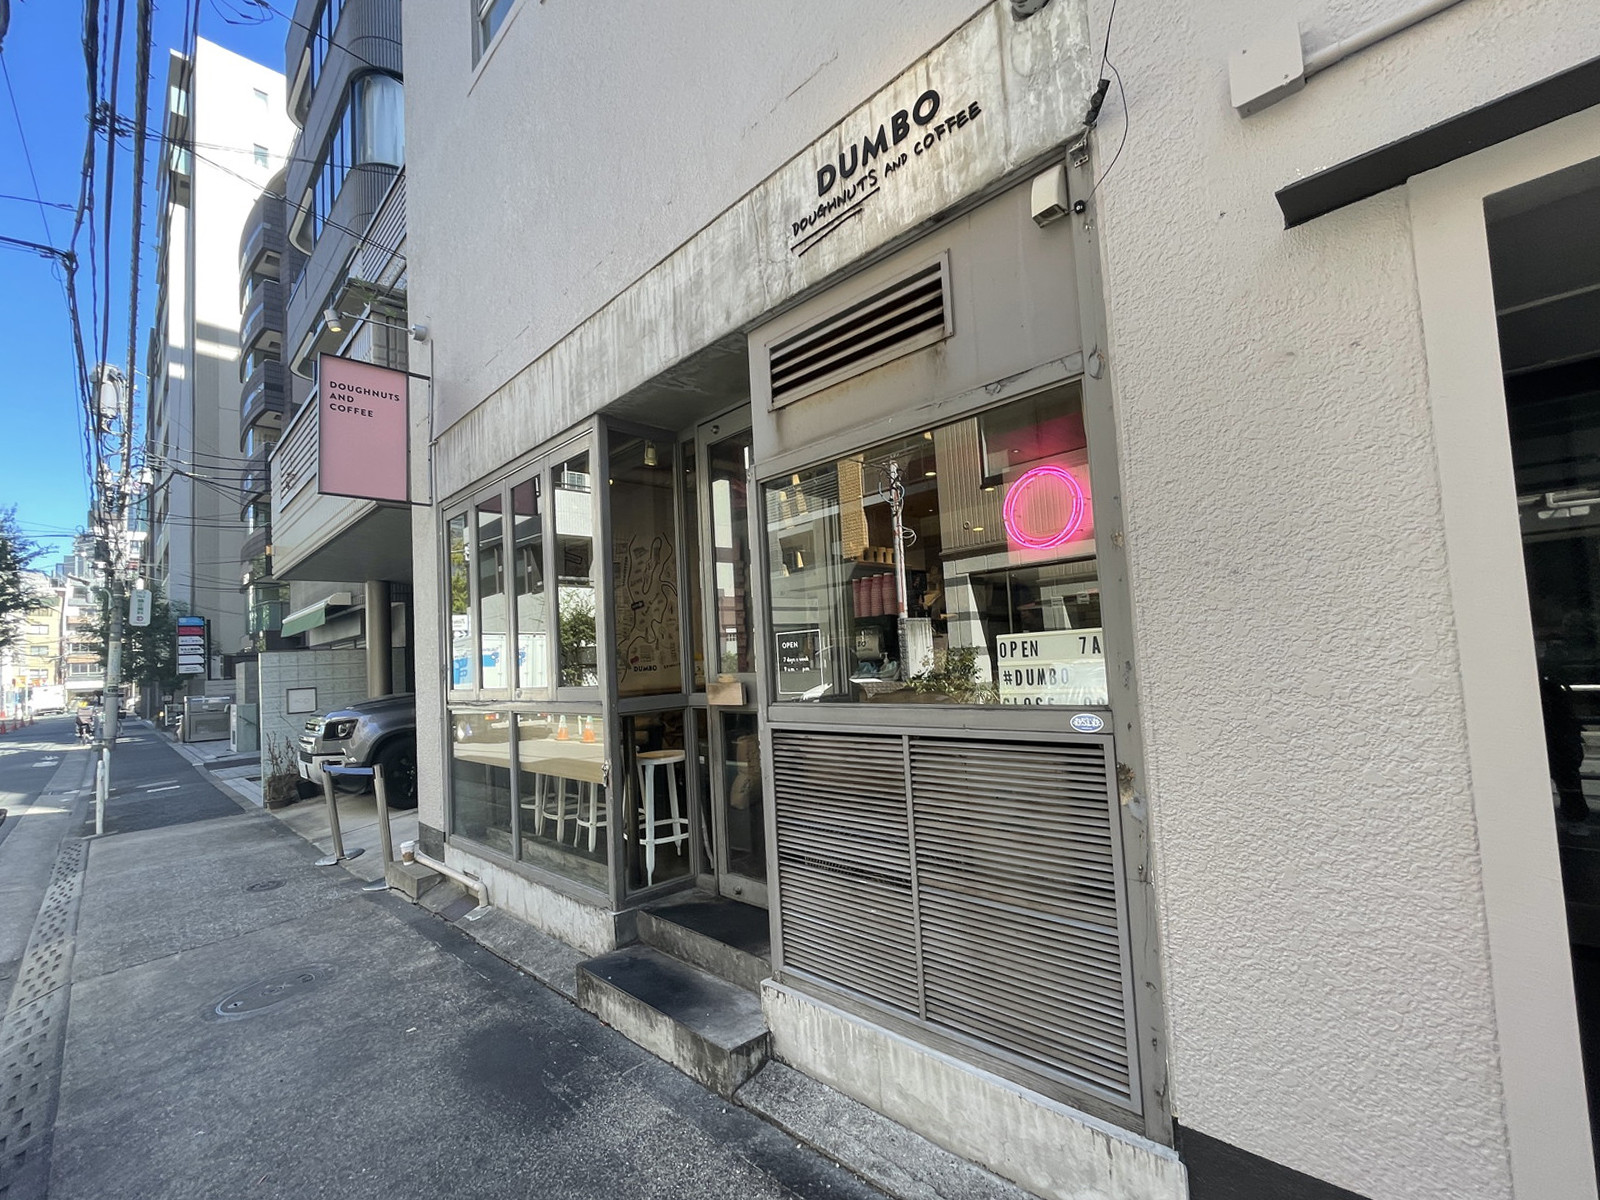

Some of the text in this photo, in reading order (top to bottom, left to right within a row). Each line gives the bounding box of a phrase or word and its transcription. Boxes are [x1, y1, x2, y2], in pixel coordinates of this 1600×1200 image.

[817, 89, 941, 198] DUMBO
[791, 101, 982, 237] DOUGHNUTS AND COFFEE
[329, 380, 400, 402] DOUGHNUTS
[329, 392, 354, 403] AND
[329, 403, 374, 418] COFFEE
[781, 641, 798, 649] OPEN
[999, 640, 1038, 658] OPEN
[634, 664, 657, 672] DUMBO
[1003, 667, 1069, 687] #DUMBO
